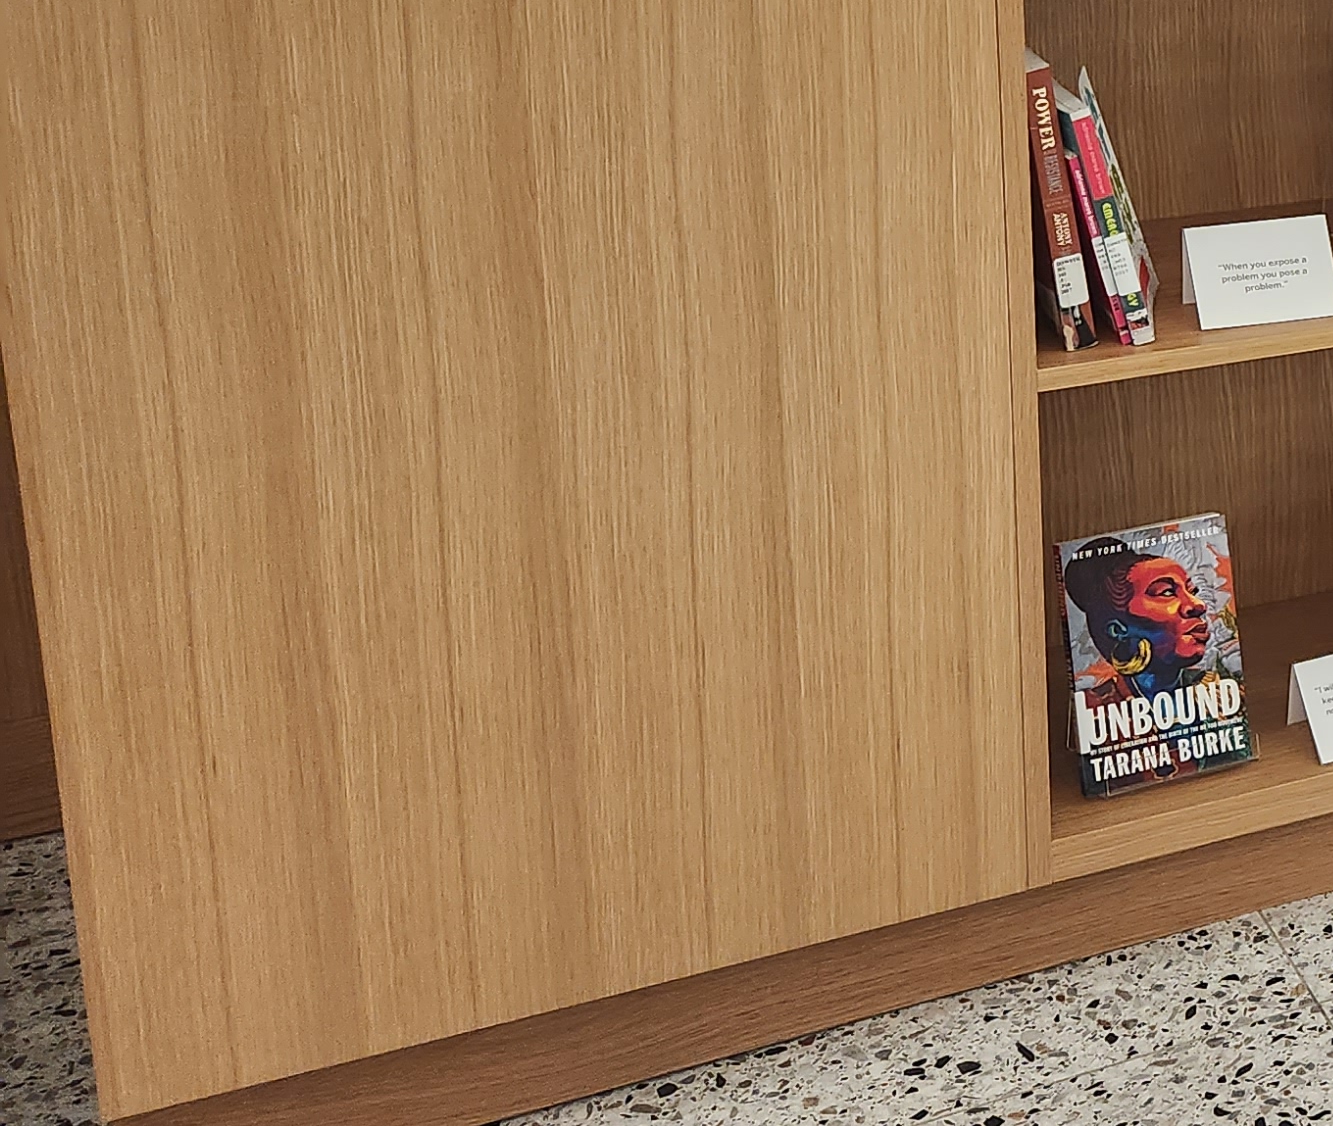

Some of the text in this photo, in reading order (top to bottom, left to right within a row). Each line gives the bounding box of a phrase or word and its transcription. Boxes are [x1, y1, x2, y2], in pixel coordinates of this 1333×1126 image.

[1032, 86, 1056, 150] POWER
[1218, 261, 1248, 272] “When
[1250, 260, 1267, 271] you
[1268, 257, 1299, 270] expose
[1221, 271, 1258, 284] problem
[1260, 271, 1277, 282] you
[1279, 269, 1300, 280] pose
[1072, 526, 1220, 561] NEW YORK TIMES BESTSELLER
[1088, 678, 1241, 746] UNBOUND
[1090, 725, 1247, 782] TARANA BURKE
